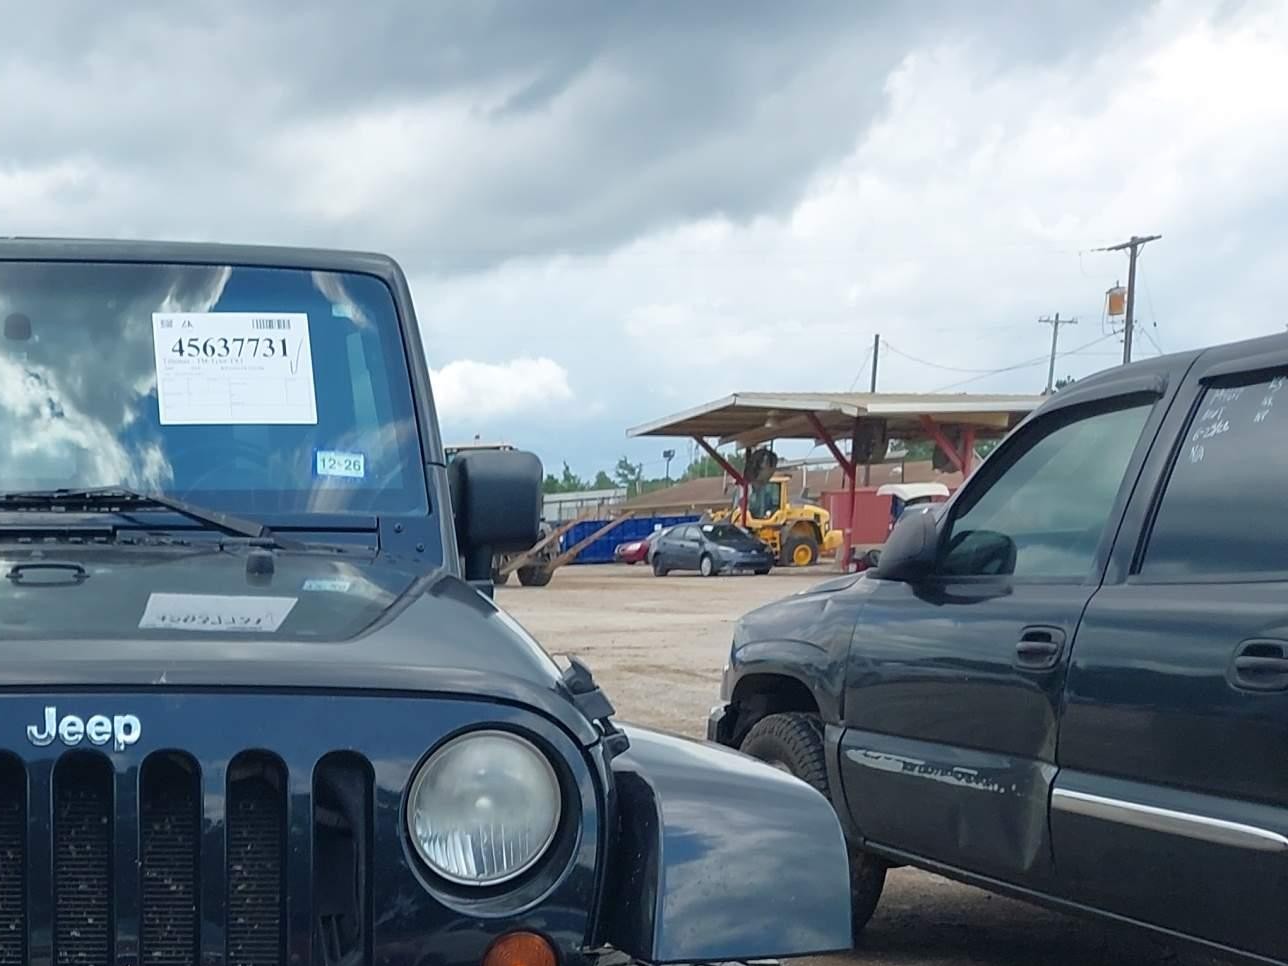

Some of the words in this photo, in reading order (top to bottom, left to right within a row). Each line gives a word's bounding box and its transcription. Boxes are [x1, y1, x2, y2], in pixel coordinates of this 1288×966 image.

[172, 337, 288, 358] 45637731
[319, 457, 362, 473] 12-26
[27, 706, 142, 752] Jeep
